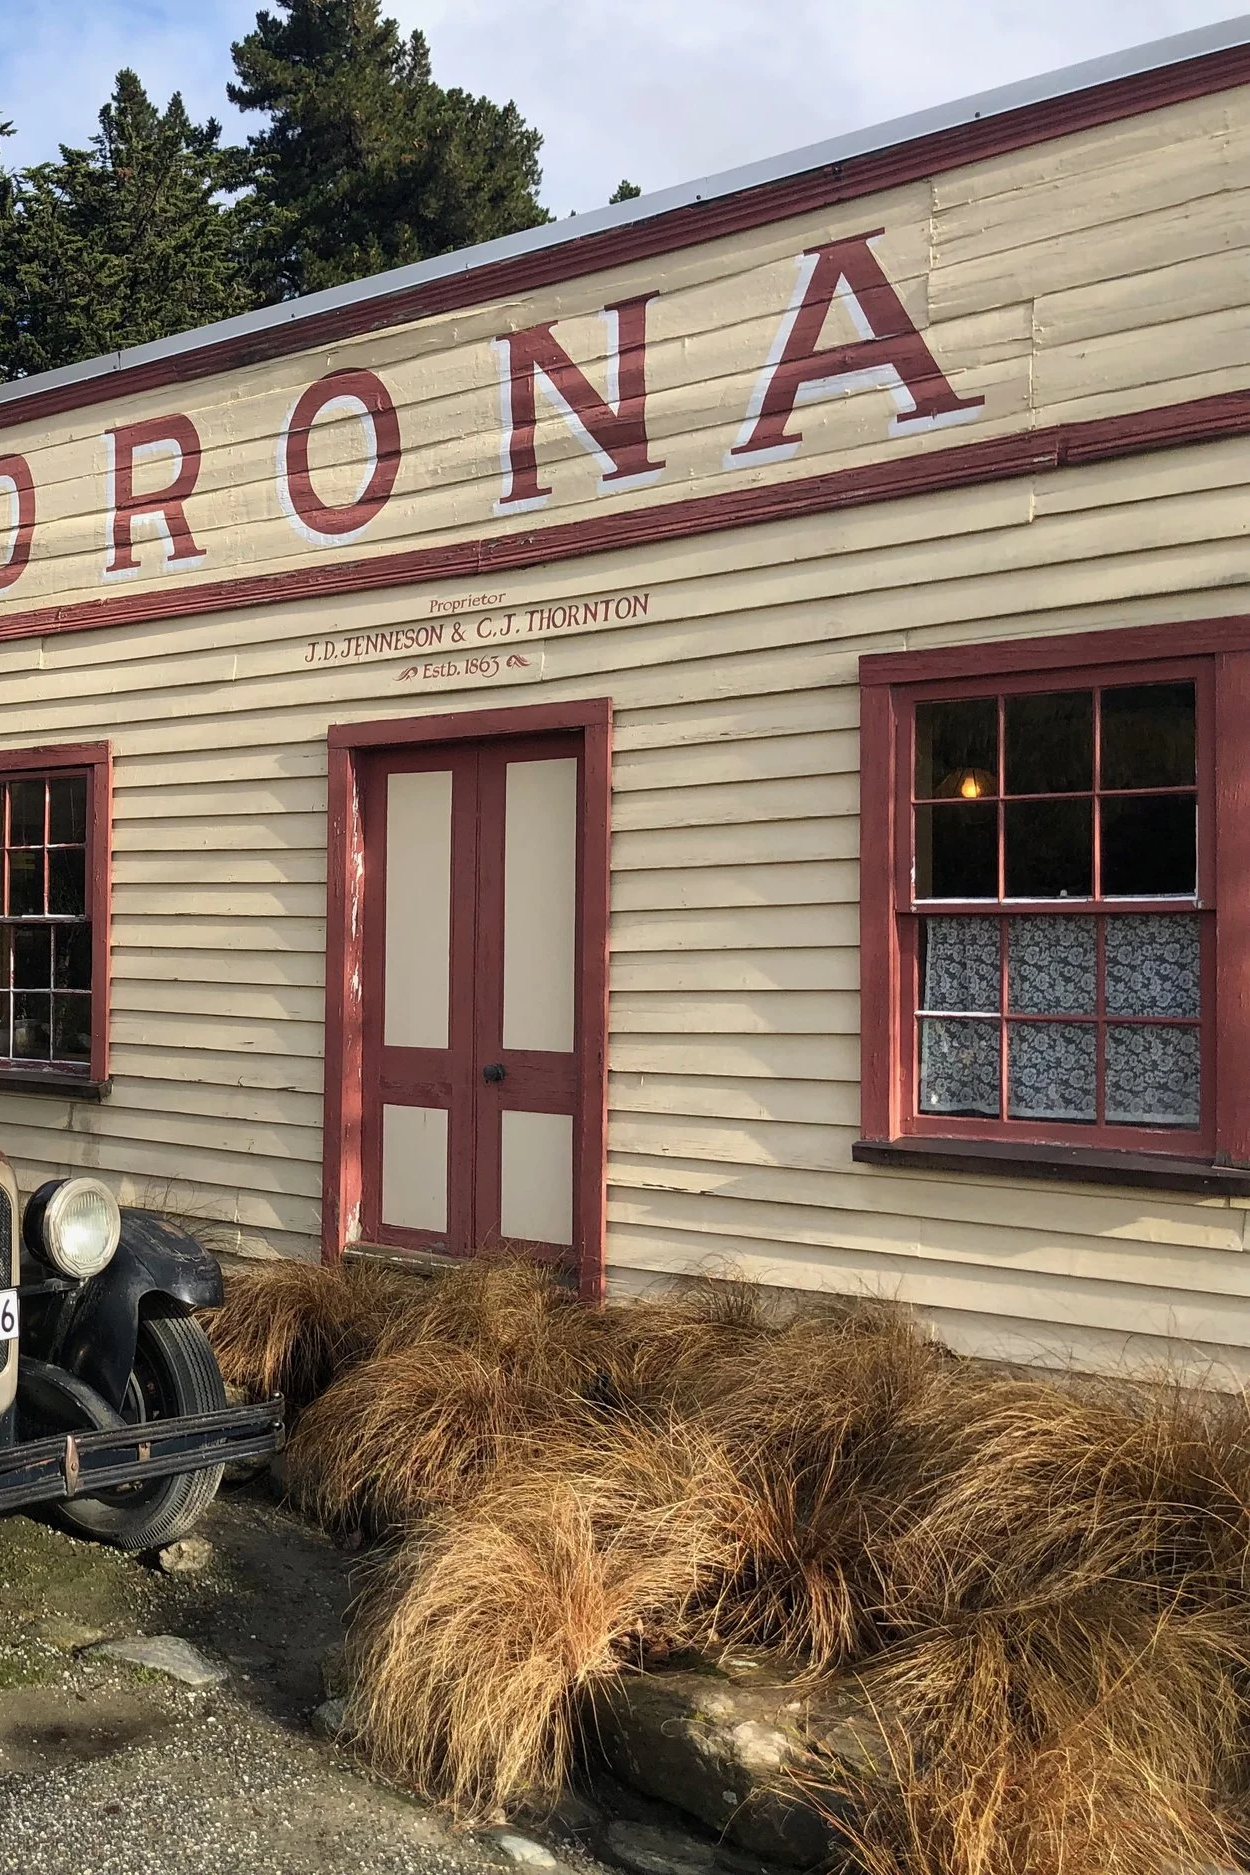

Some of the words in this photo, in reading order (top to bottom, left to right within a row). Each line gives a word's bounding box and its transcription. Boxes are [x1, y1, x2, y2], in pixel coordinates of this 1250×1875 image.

[429, 592, 507, 613] Proprietor
[450, 621, 467, 643] &
[524, 592, 650, 633] THORNTON
[422, 660, 461, 680] Estb.
[464, 655, 501, 679] 1863
